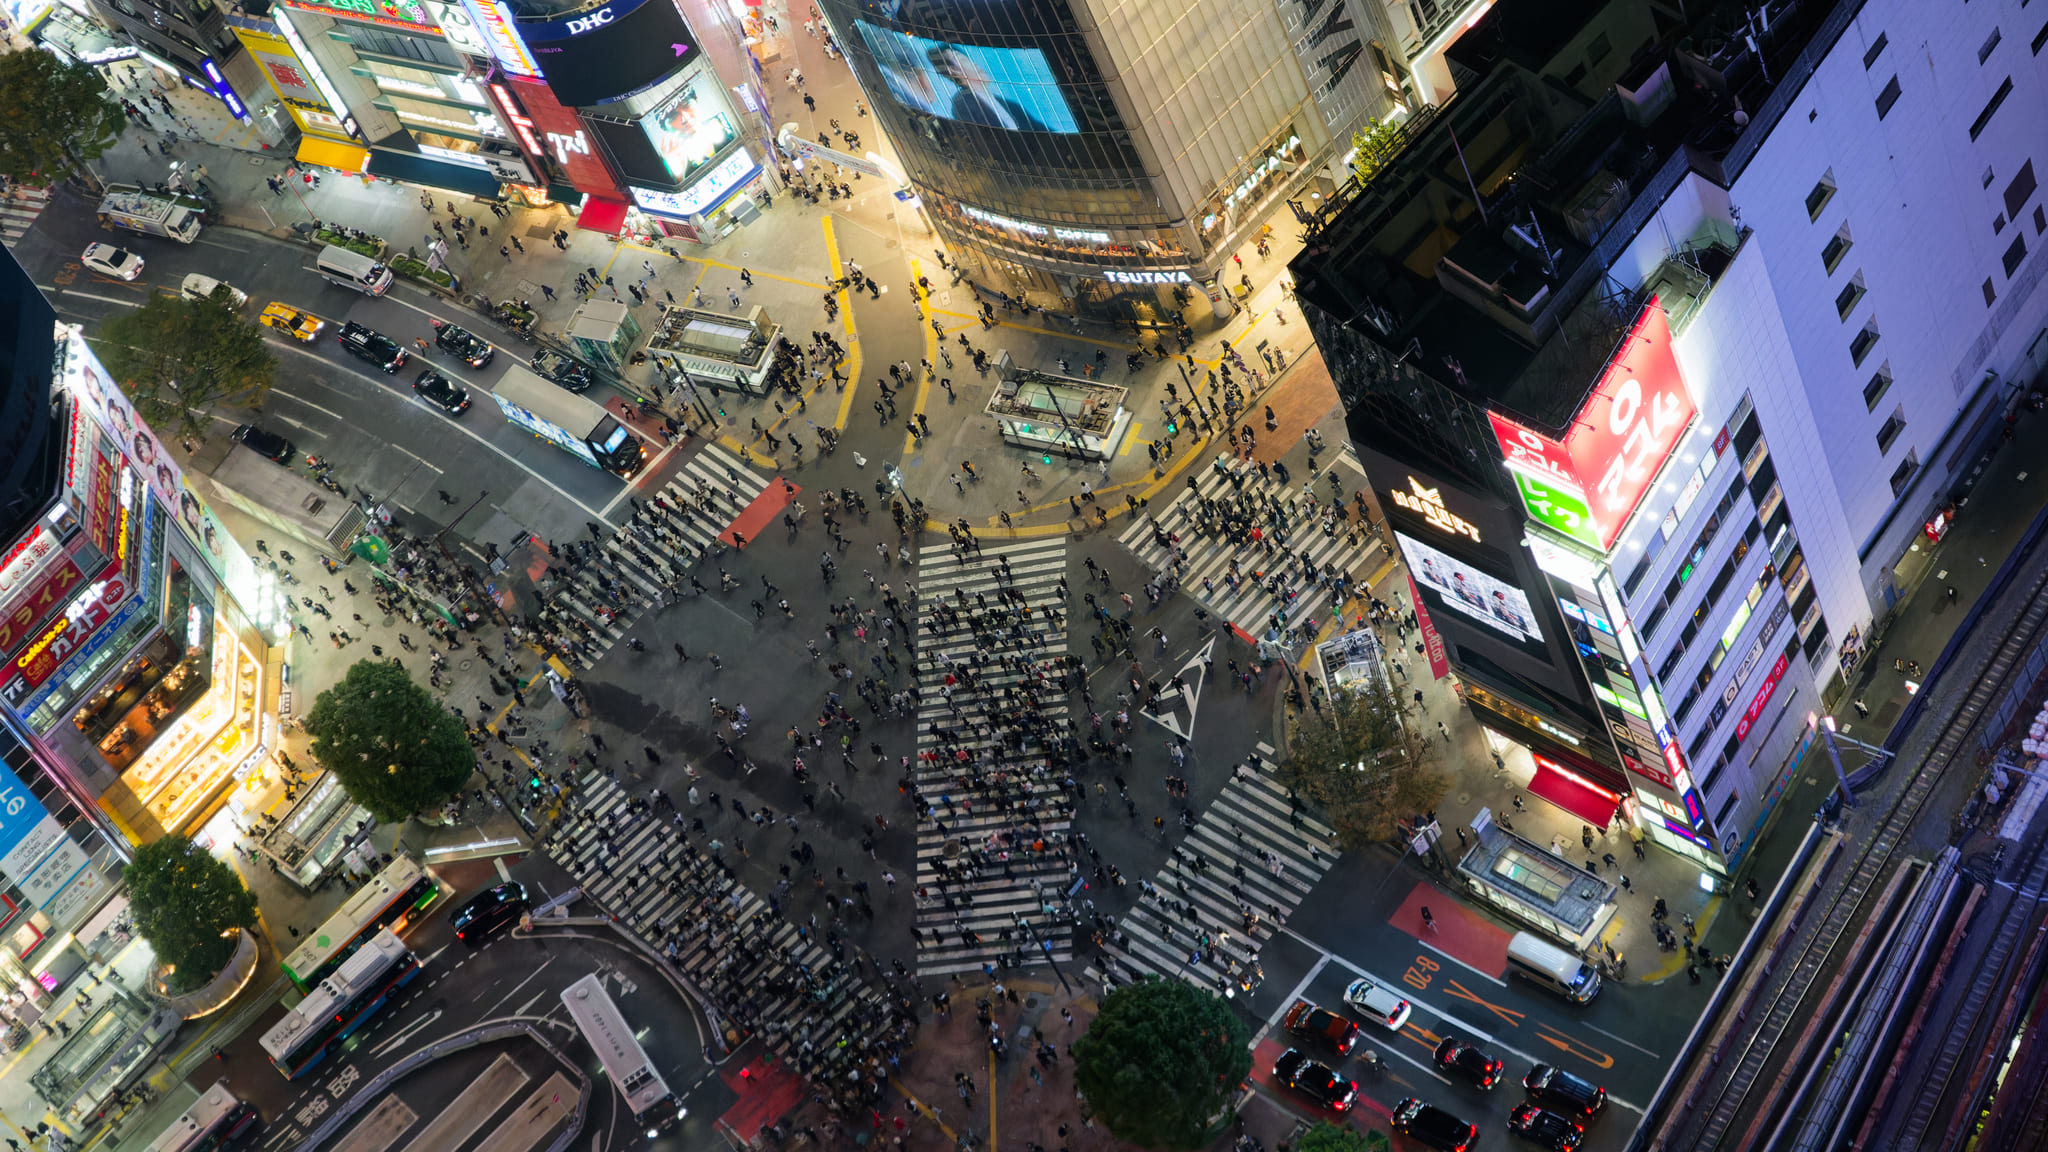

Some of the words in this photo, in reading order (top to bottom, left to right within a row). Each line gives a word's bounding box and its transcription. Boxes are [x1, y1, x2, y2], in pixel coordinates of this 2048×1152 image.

[566, 7, 615, 35] DHC
[1225, 133, 1302, 210] TSUTAYA
[1103, 270, 1192, 283] TSUTAYA
[3, 676, 26, 701] 7F
[1749, 676, 1775, 720] アコム
[1402, 955, 1441, 991] 8-20
